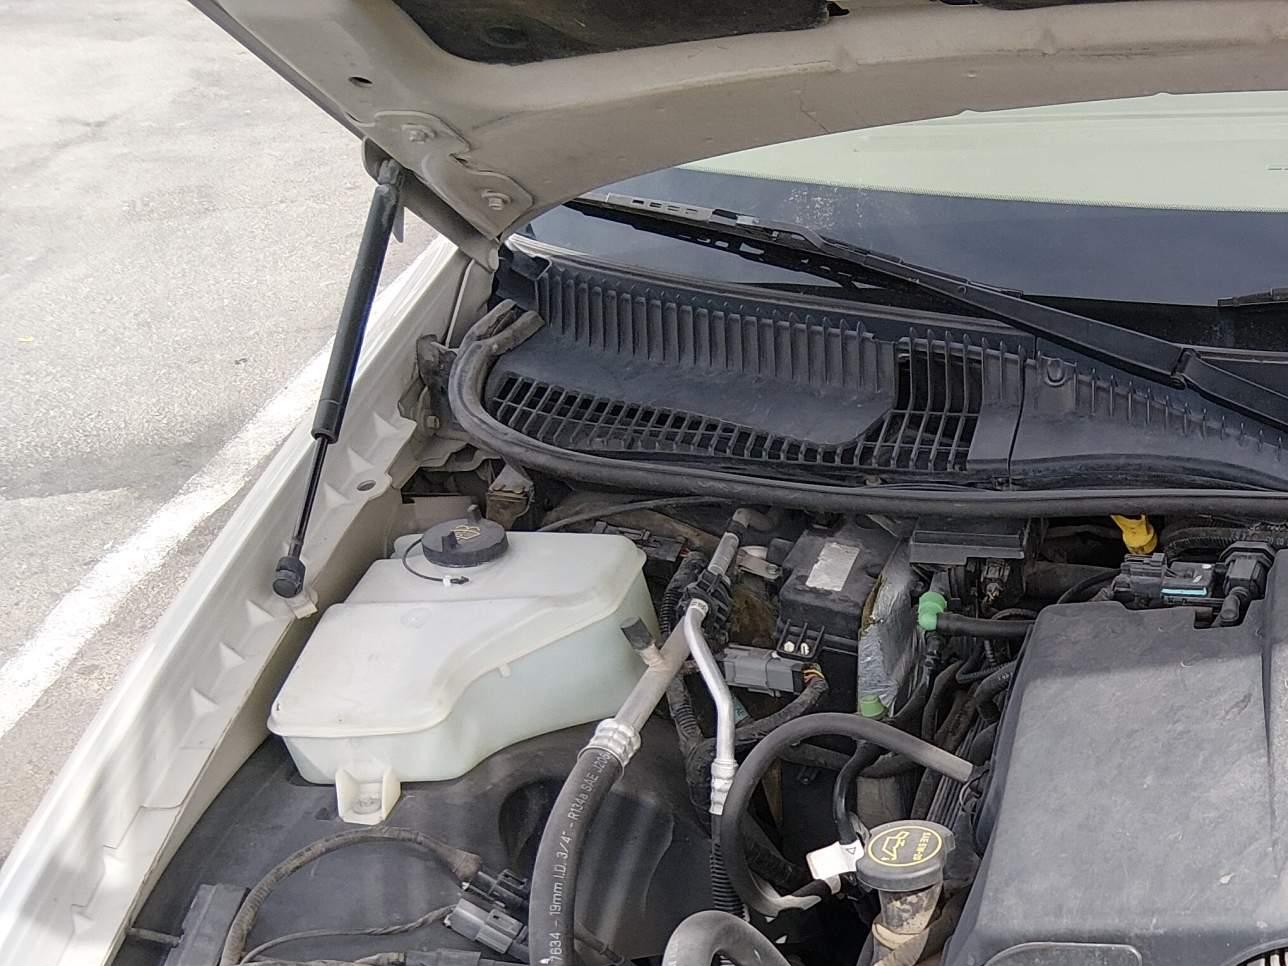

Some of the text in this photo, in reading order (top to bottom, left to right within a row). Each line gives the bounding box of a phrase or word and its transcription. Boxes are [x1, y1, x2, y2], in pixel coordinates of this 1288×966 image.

[582, 772, 600, 794] SAE
[568, 792, 590, 822] R134a
[552, 858, 568, 879] I.D.
[550, 882, 563, 915] 19mm
